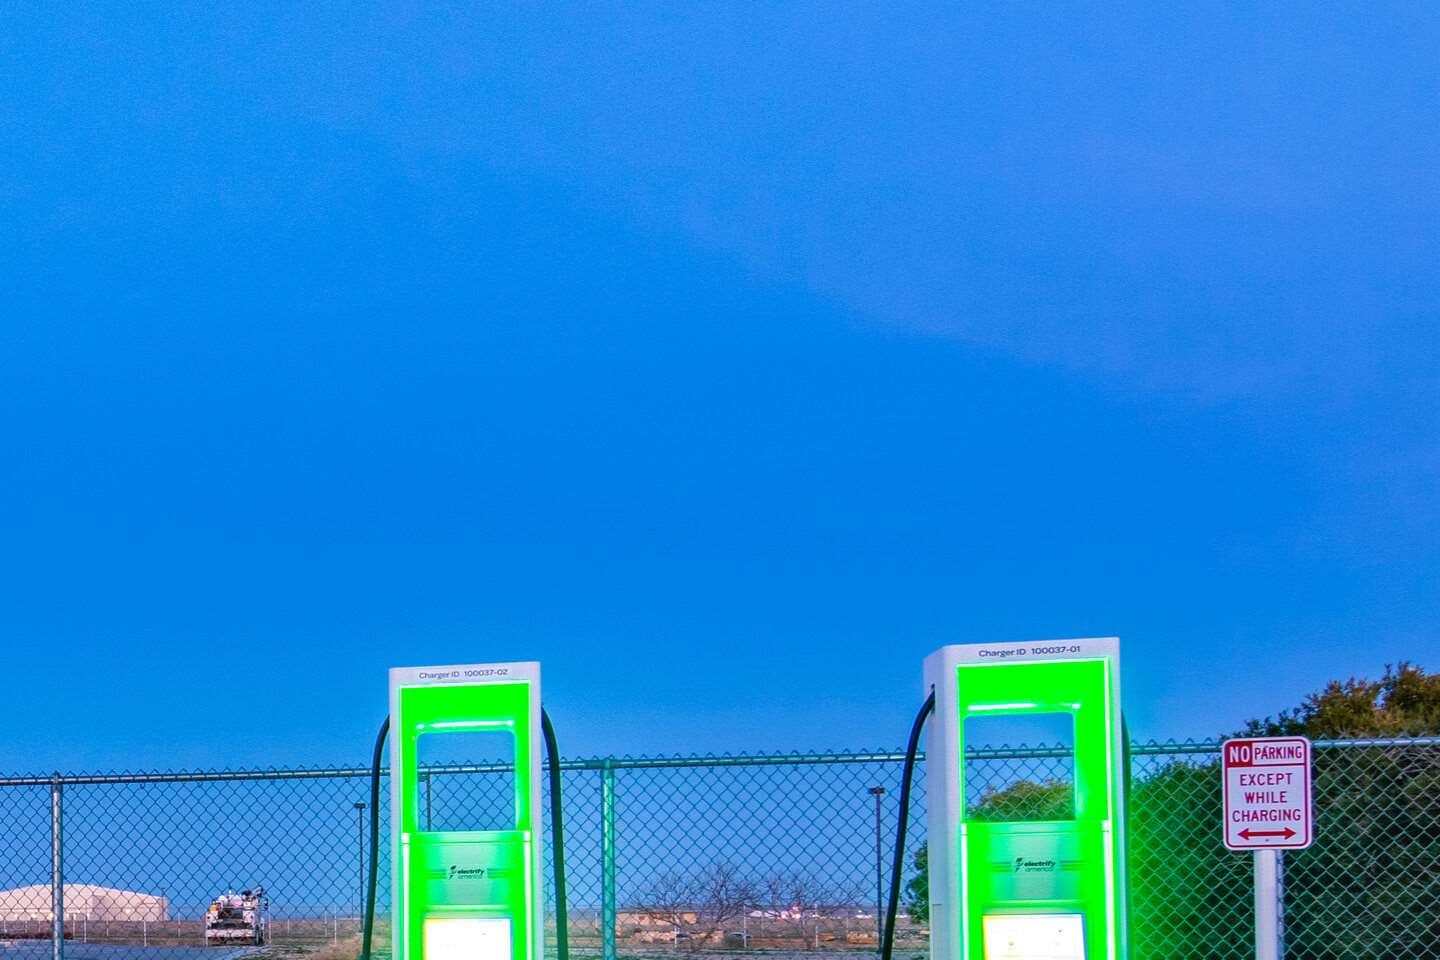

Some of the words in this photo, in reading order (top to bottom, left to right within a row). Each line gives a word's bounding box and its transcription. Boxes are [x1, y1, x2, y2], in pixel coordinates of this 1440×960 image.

[978, 649, 1014, 657] Charger
[1031, 646, 1081, 655] 100037-01
[464, 669, 508, 677] 100037-02
[1230, 746, 1250, 763] NO
[1254, 746, 1303, 760] PARKING
[1240, 773, 1292, 786] EXCEPT
[1245, 791, 1288, 804] WHILE
[1232, 809, 1301, 823] CHARGING
[1024, 861, 1056, 869] electrify
